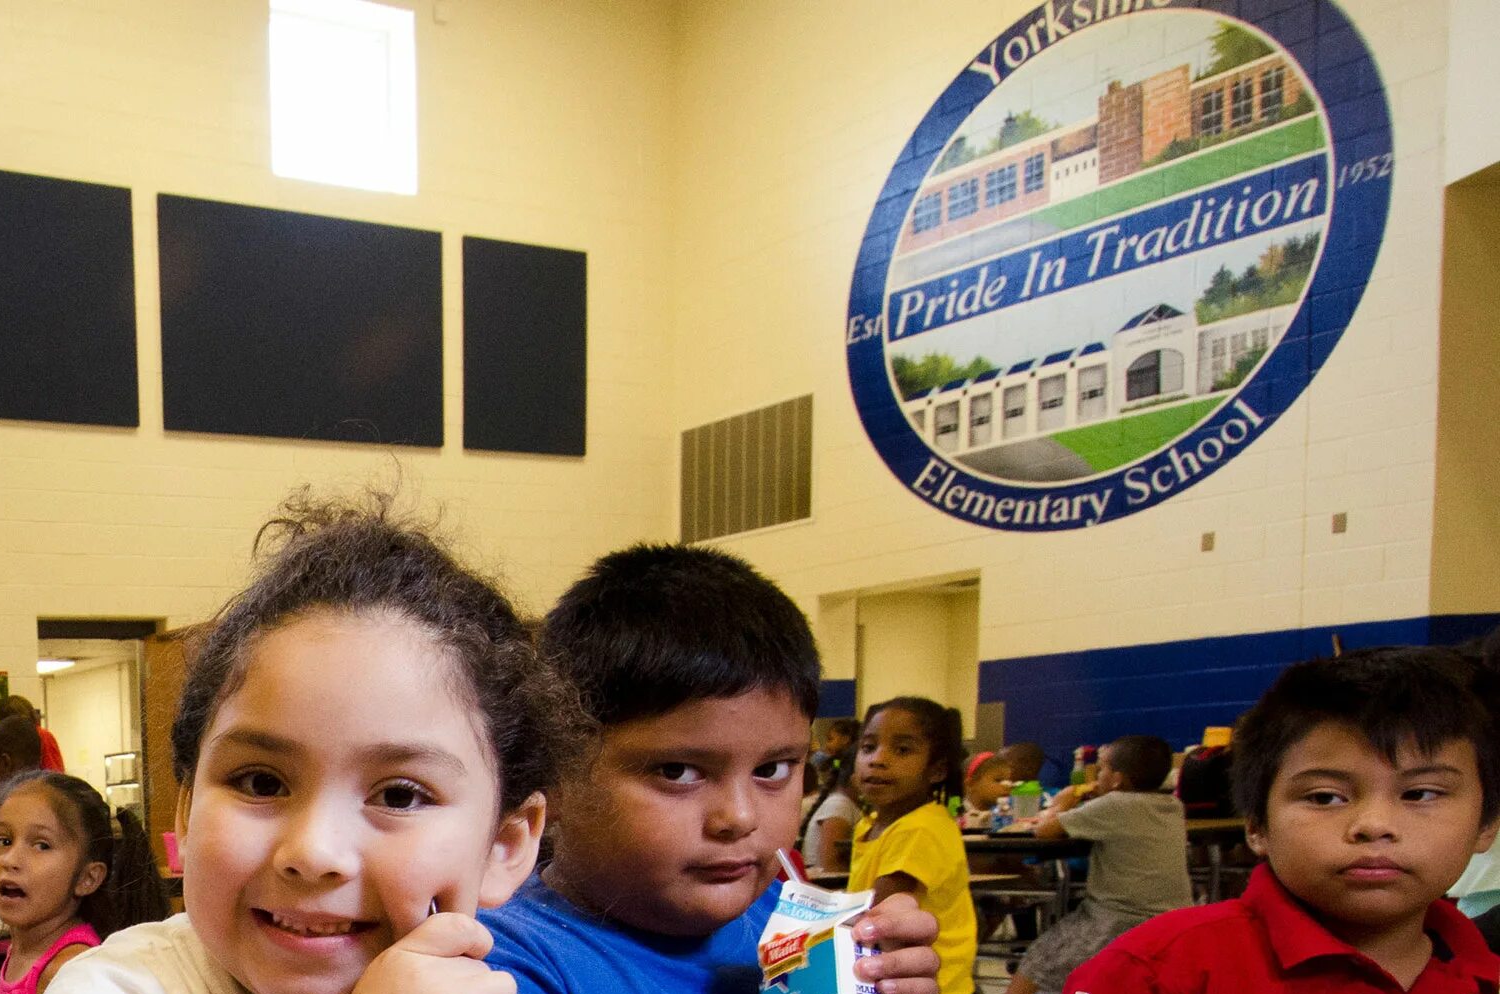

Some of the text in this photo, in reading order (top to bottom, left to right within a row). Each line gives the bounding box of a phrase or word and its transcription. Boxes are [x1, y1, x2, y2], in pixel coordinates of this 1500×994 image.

[1338, 152, 1394, 189] 1952
[895, 177, 1319, 338] Pride In Tradition
[911, 398, 1265, 528] Elementary School
